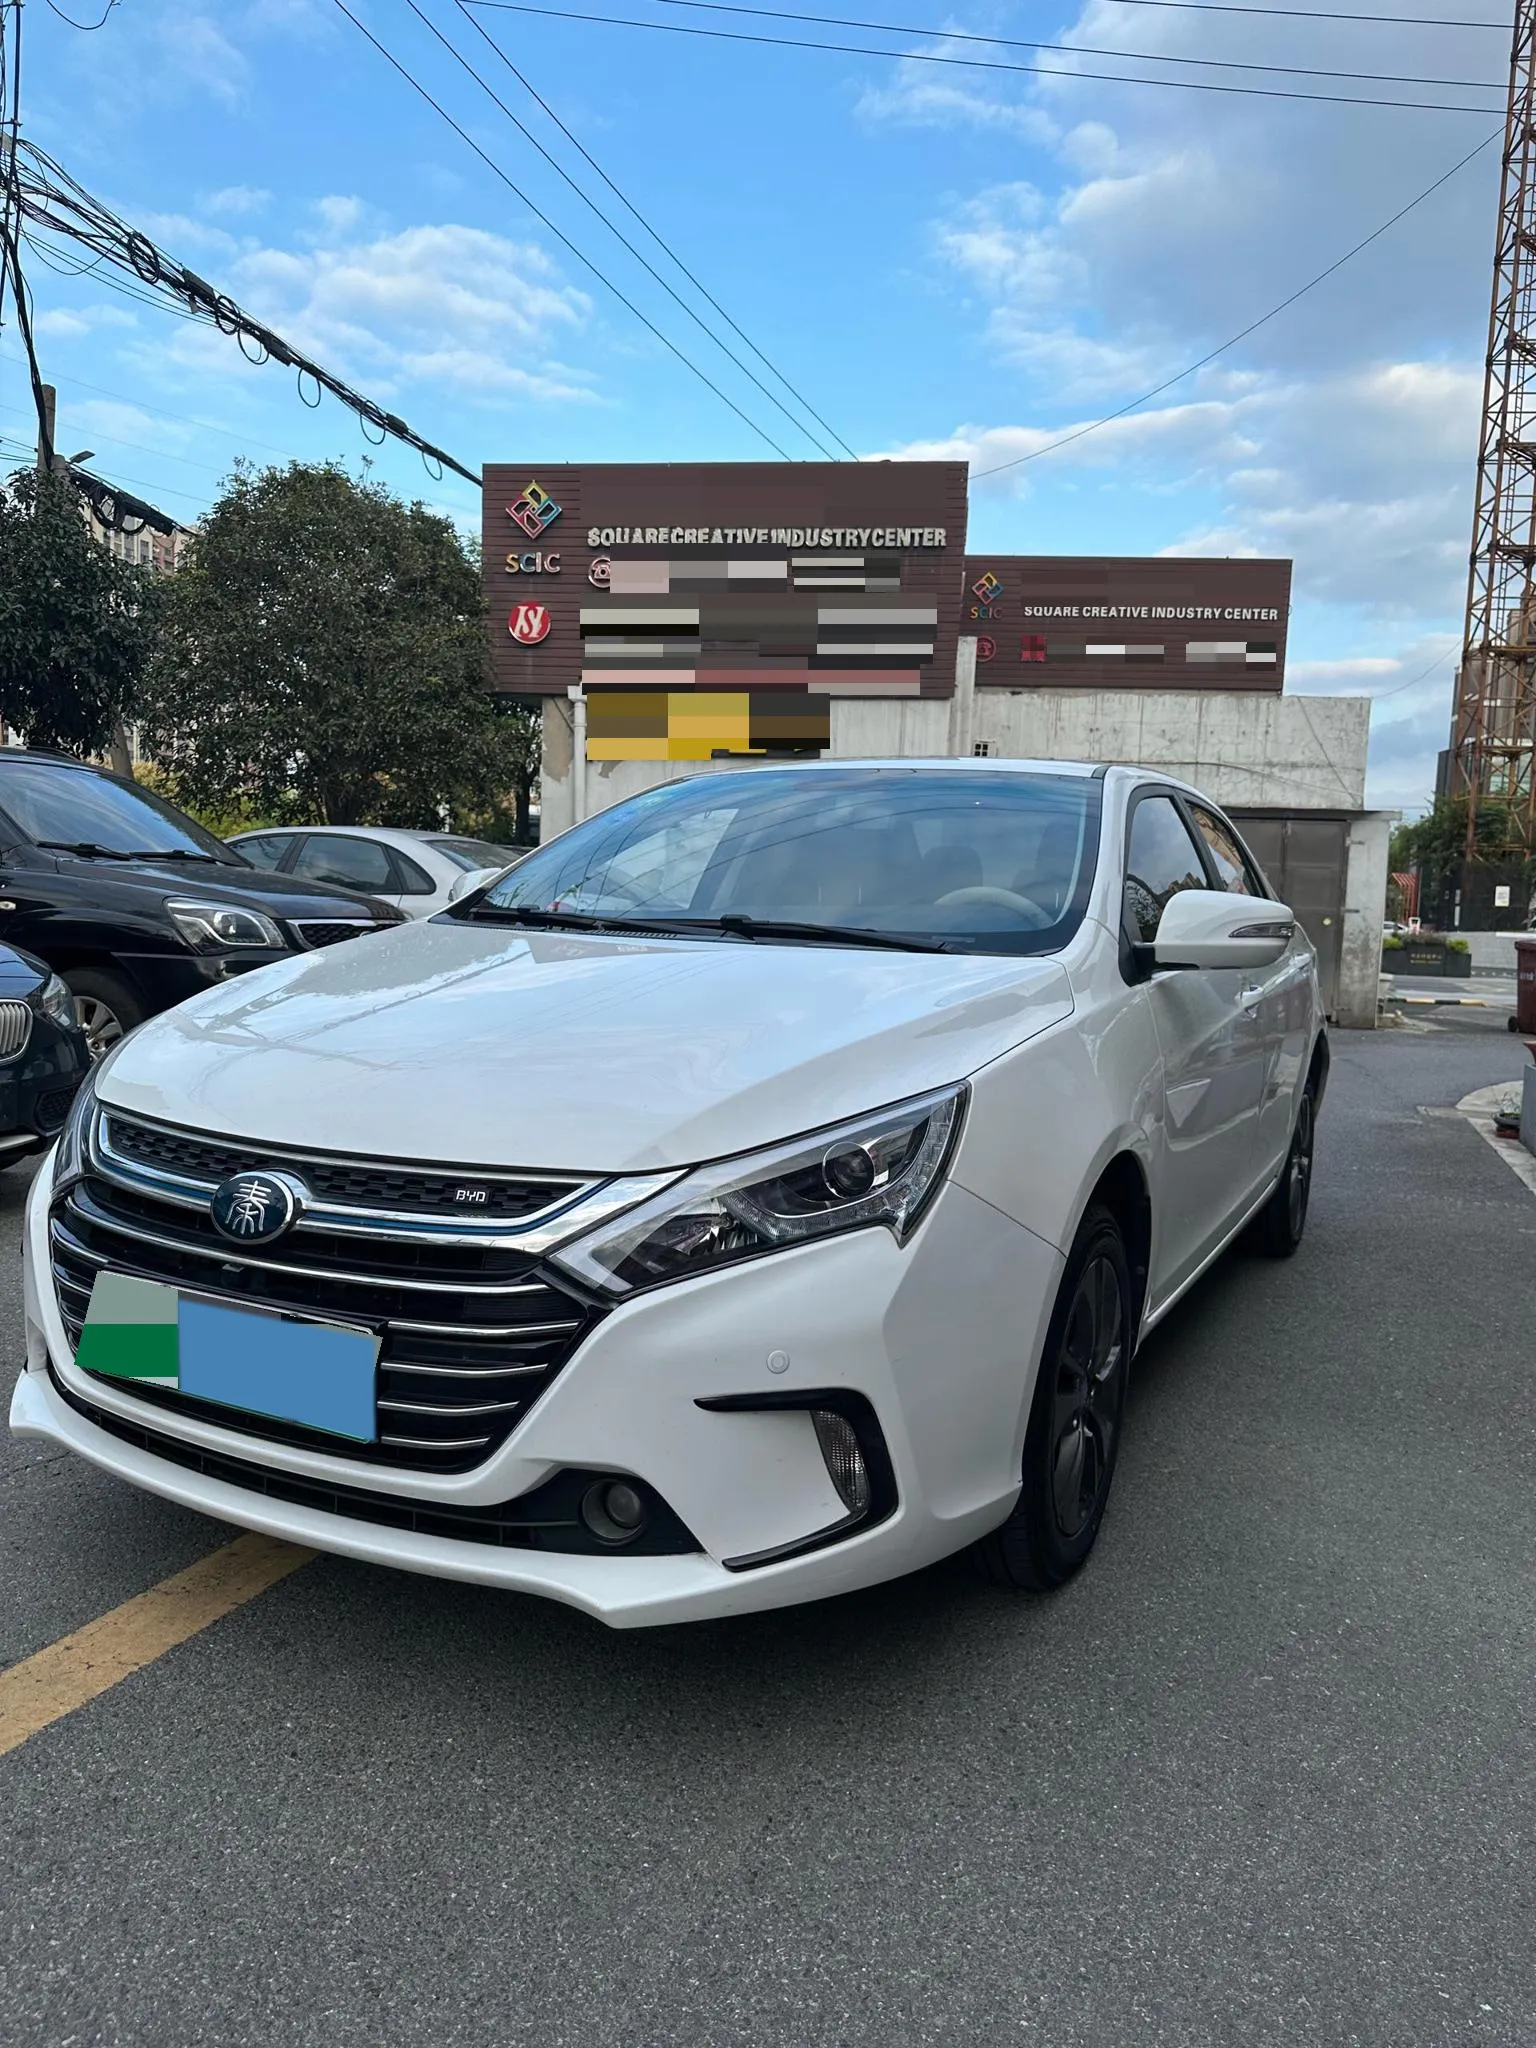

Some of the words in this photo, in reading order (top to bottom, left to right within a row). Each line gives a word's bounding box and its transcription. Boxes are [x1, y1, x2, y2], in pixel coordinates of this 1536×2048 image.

[587, 527, 669, 547] SQUARE
[670, 527, 768, 544] CREATIVE
[770, 528, 871, 547] INDUSTRY
[871, 528, 947, 547] CENTER
[504, 551, 561, 573] SCIC
[1024, 606, 1079, 617] SQUARE
[1082, 606, 1149, 618] CREATIVE
[1151, 607, 1222, 619] INDUSTRY
[1224, 608, 1278, 620] CENTER
[455, 1189, 486, 1202] BYD
[225, 1180, 272, 1234] 秦
